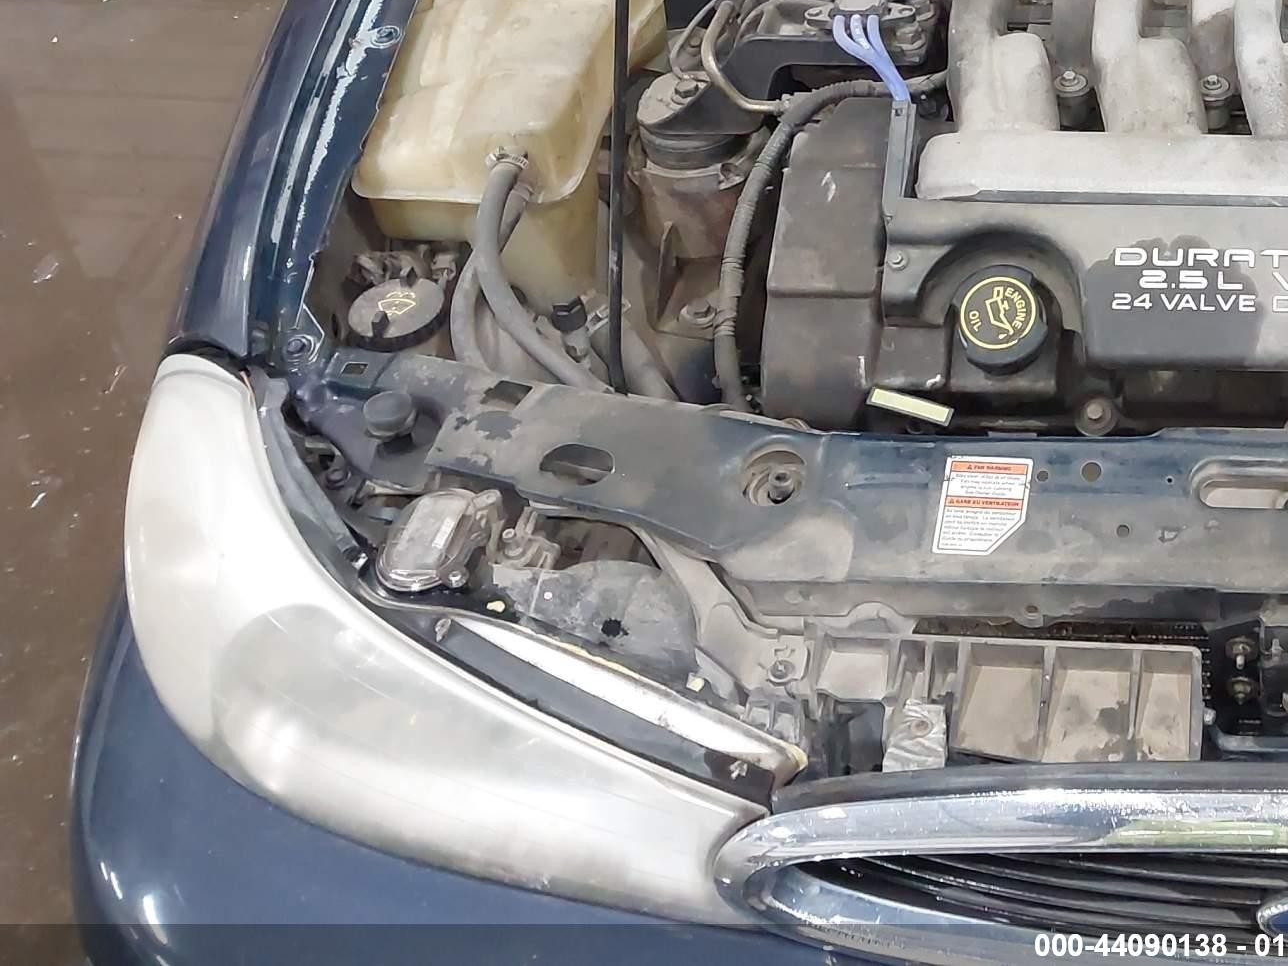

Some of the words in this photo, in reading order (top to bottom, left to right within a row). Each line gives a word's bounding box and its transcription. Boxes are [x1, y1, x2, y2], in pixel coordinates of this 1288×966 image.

[1004, 287, 1028, 330] ENGINE
[1111, 292, 1153, 311] 24
[1159, 294, 1257, 312] VALVE
[969, 309, 983, 332] OIL
